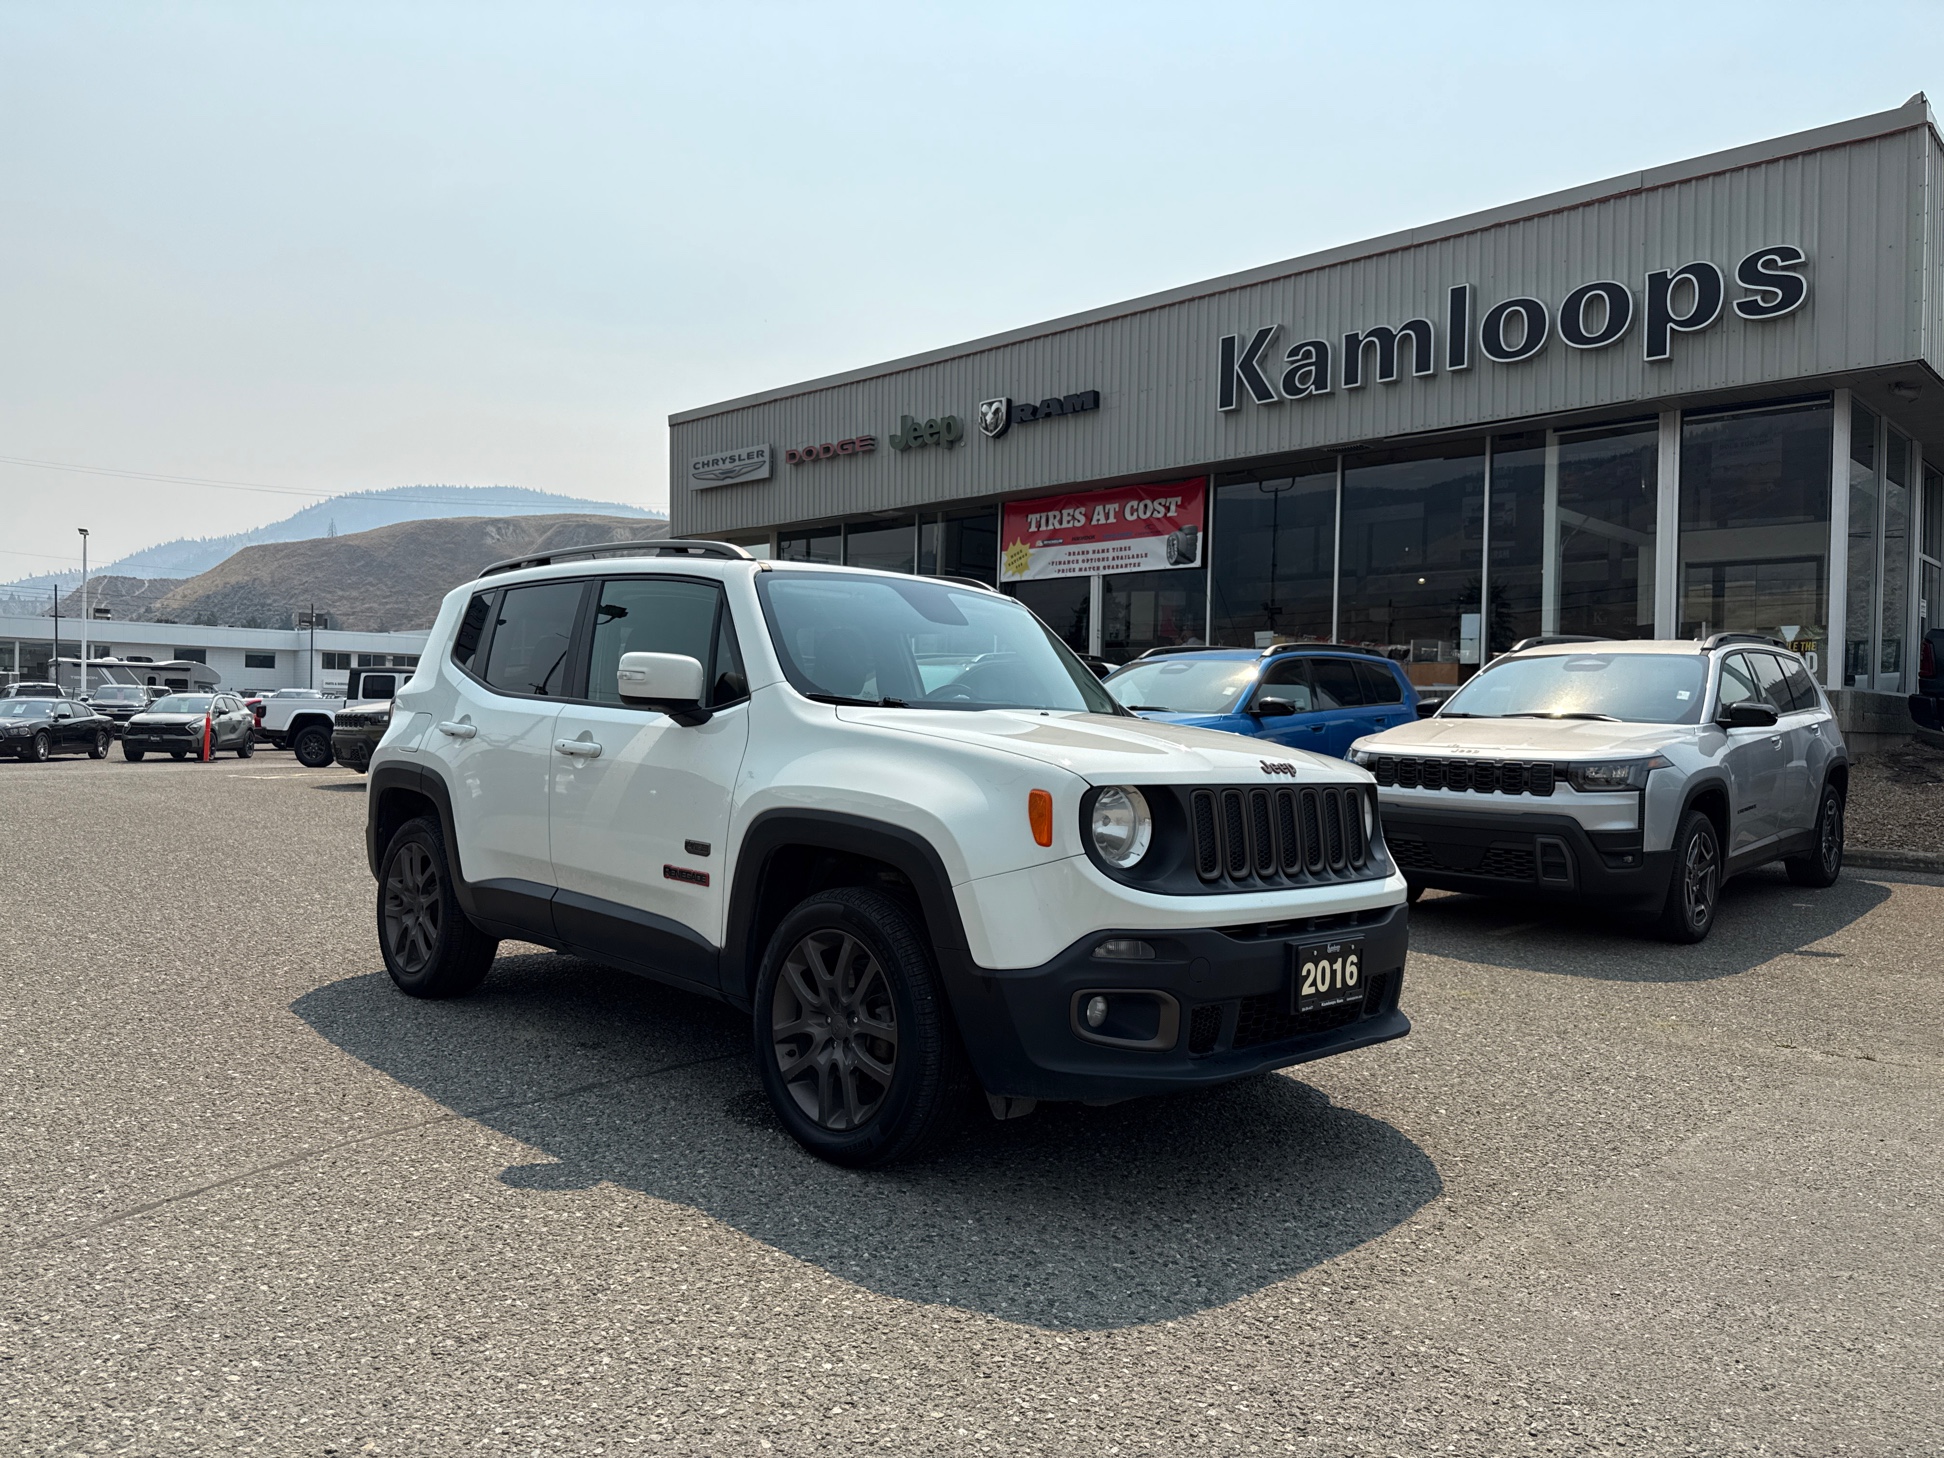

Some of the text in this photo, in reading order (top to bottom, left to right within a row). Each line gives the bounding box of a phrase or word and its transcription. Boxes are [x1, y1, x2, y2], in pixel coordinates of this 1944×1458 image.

[1217, 242, 1811, 412] Kamloops
[1014, 390, 1100, 424] RAM
[890, 413, 964, 452] Jeep
[691, 448, 766, 471] CHRYSLER
[785, 434, 878, 465] DODGE
[1027, 496, 1182, 533] TIRES AT COST
[1051, 552, 1148, 566] FINANCE OPTIONS AVAILABLE
[1103, 562, 1141, 571] GUARANTEE
[1801, 641, 1817, 651] THE
[1259, 759, 1297, 778] Jeep
[663, 864, 710, 887] RENEGADE
[1301, 954, 1358, 996] 2016
